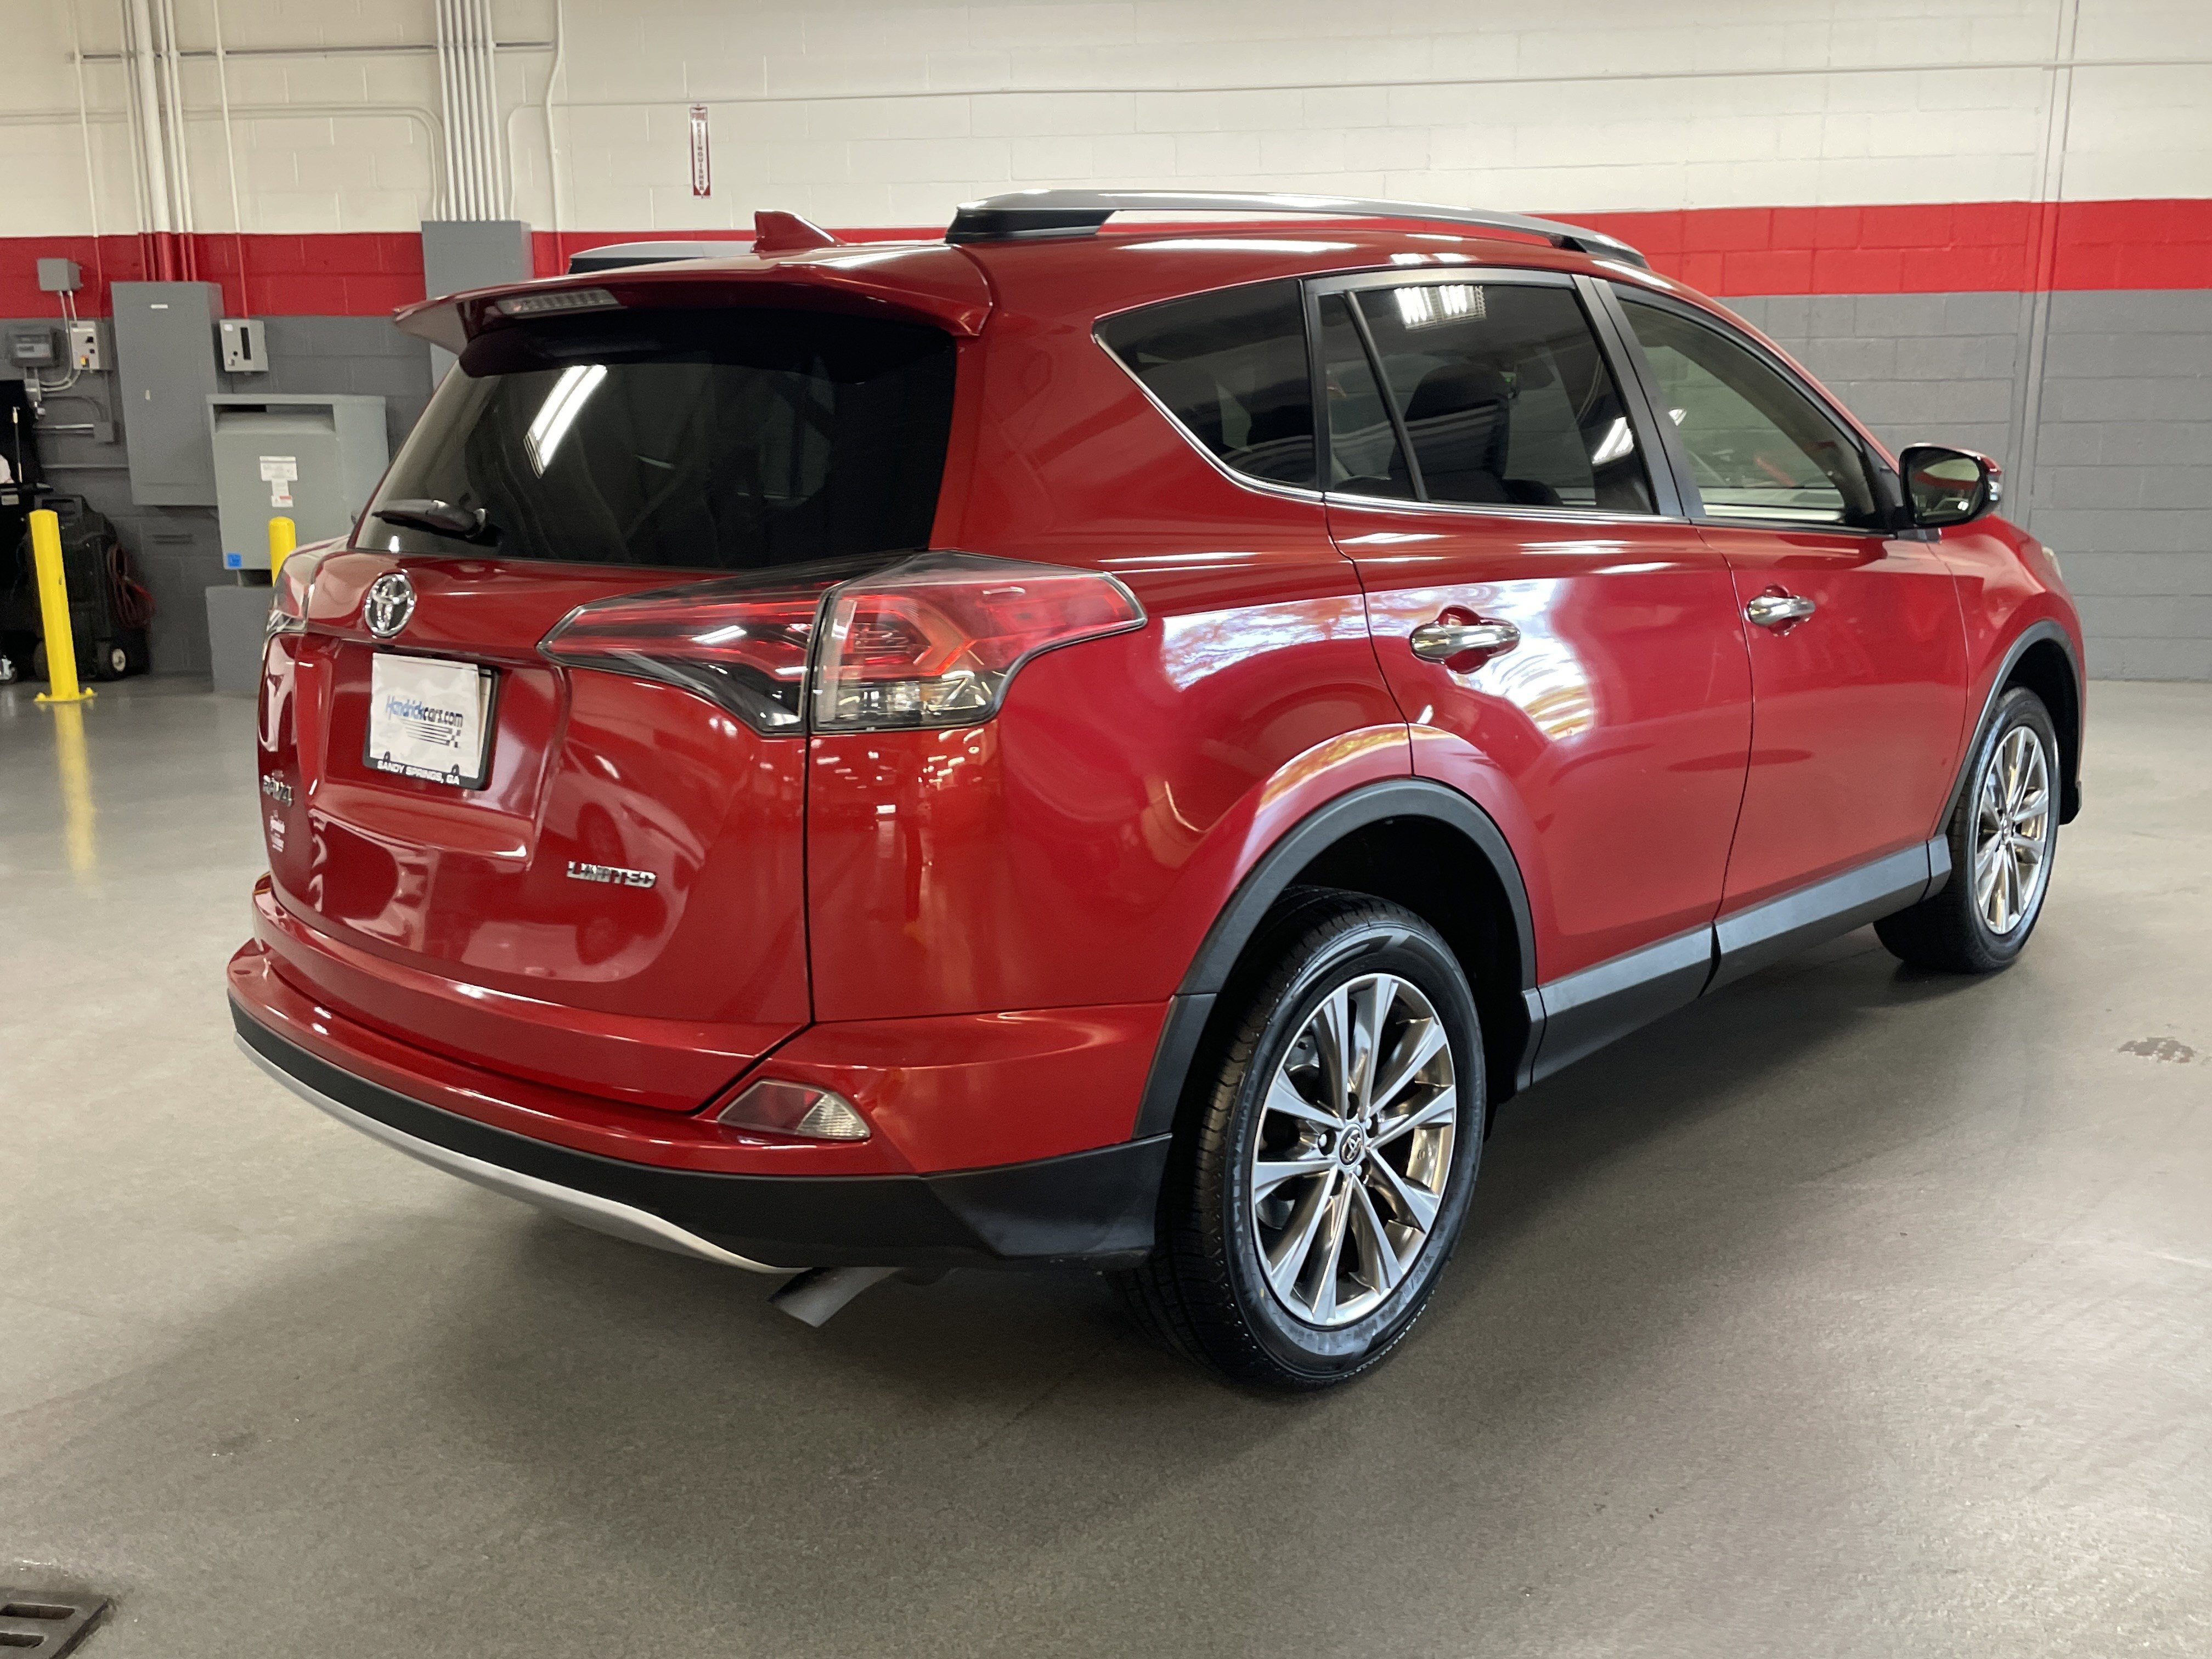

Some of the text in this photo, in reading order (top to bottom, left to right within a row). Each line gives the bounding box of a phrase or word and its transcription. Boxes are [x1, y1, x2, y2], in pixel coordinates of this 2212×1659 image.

[377, 760, 460, 785] SANDY SPRINGS, GA
[263, 775, 292, 808] RAV4
[566, 861, 656, 888] LIMITED
